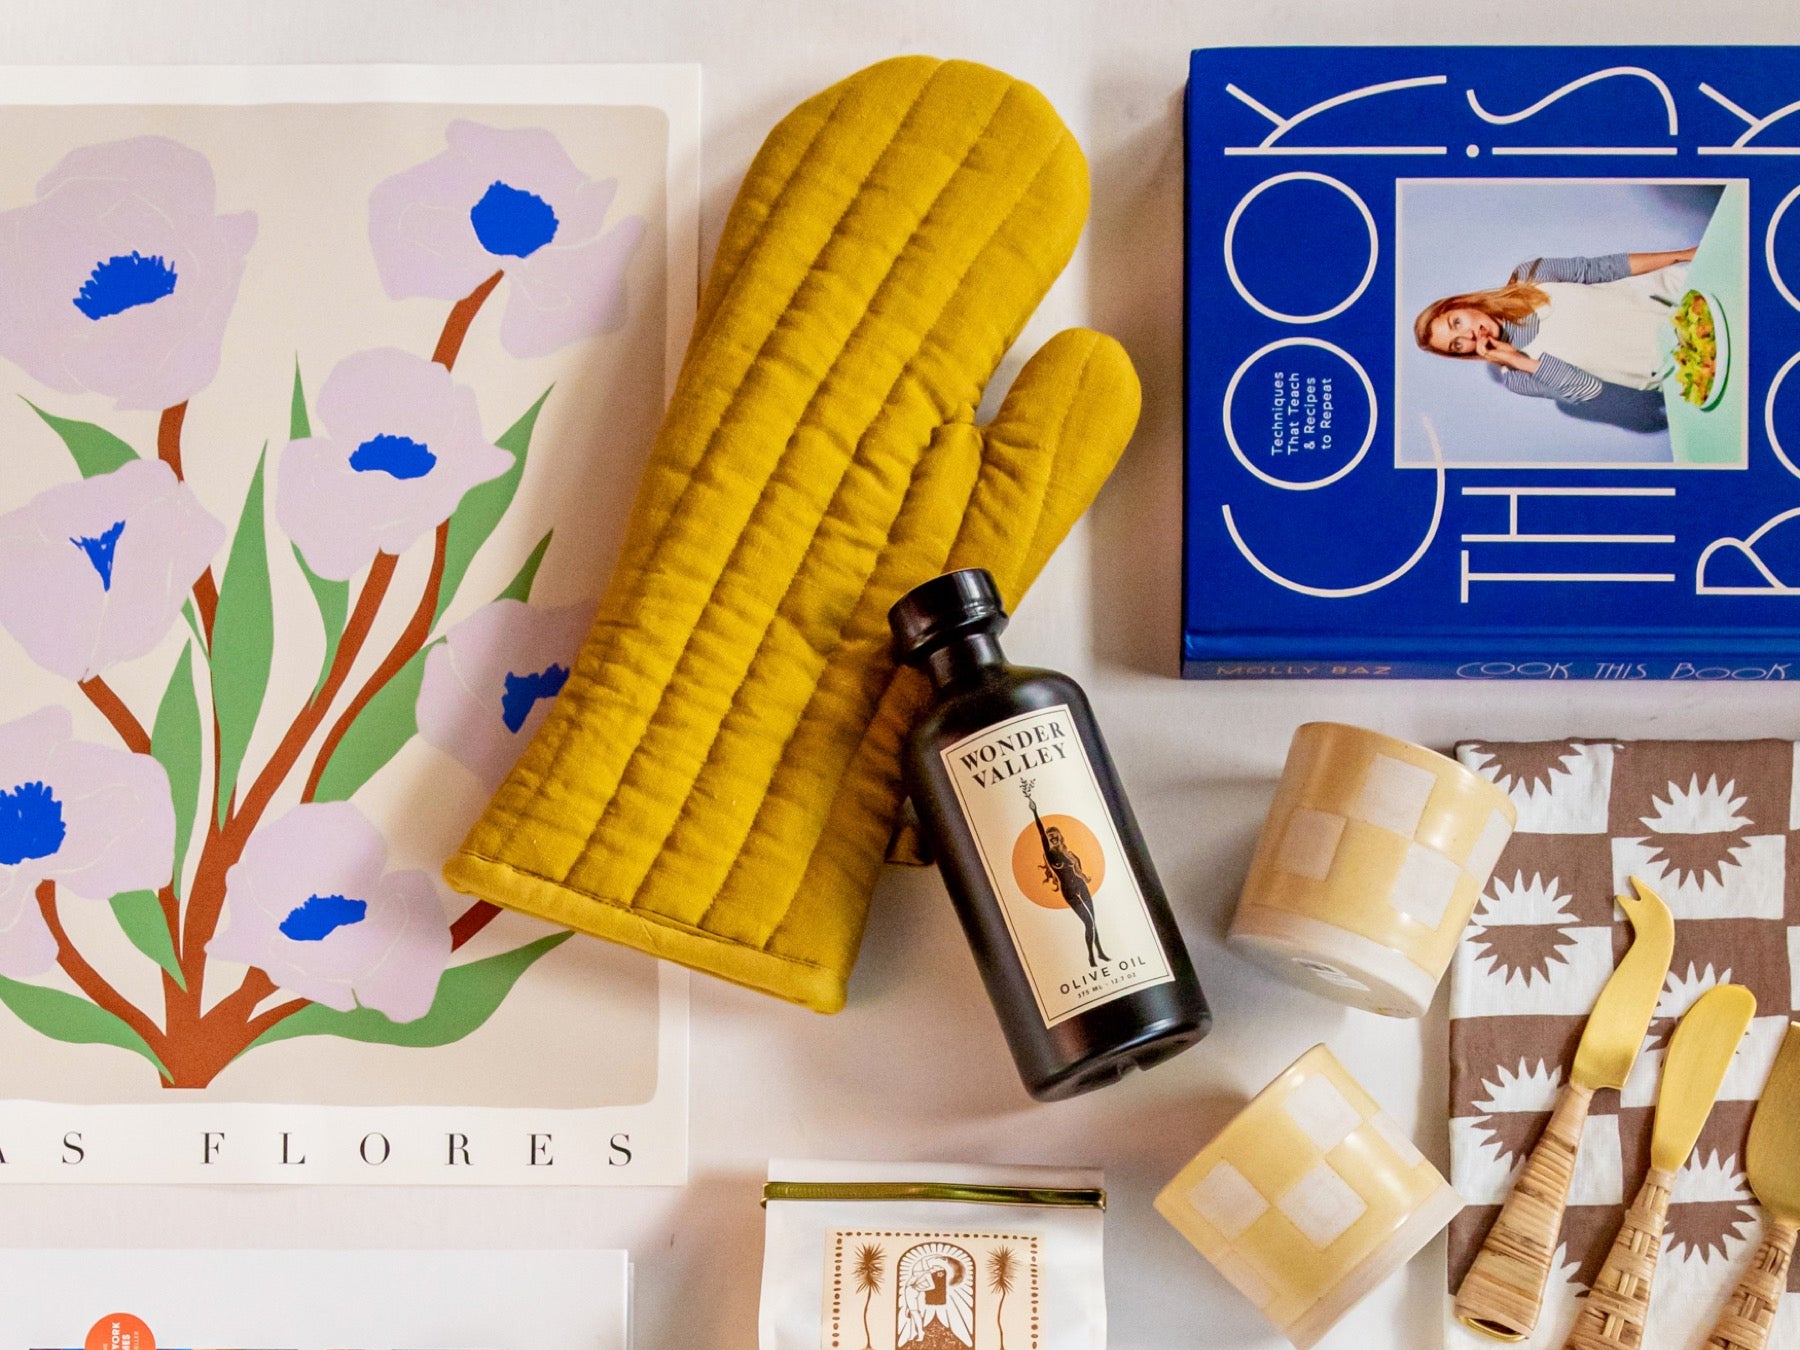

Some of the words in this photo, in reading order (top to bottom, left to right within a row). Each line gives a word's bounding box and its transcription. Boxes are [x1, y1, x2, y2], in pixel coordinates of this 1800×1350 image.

[1222, 74, 1448, 598] COOK
[1271, 371, 1286, 456] Techniques
[1287, 372, 1300, 416] Teach
[1303, 377, 1318, 434] Recipes
[1320, 378, 1334, 429] Repeat
[1287, 421, 1300, 456] That
[1303, 440, 1315, 450] &
[1321, 434, 1332, 450] to
[1216, 665, 1318, 675] MOLLY
[1331, 665, 1392, 675] BAZ
[1456, 662, 1573, 680] COOK
[1594, 662, 1647, 680] THIS
[1671, 662, 1793, 680] BOOK
[960, 721, 1066, 772] WONDER
[972, 742, 1067, 789] VALLEY
[1060, 966, 1111, 995] OLIVE
[1119, 956, 1146, 971] OIL
[199, 1131, 634, 1167] FLORES
[111, 1322, 120, 1350] YORK
